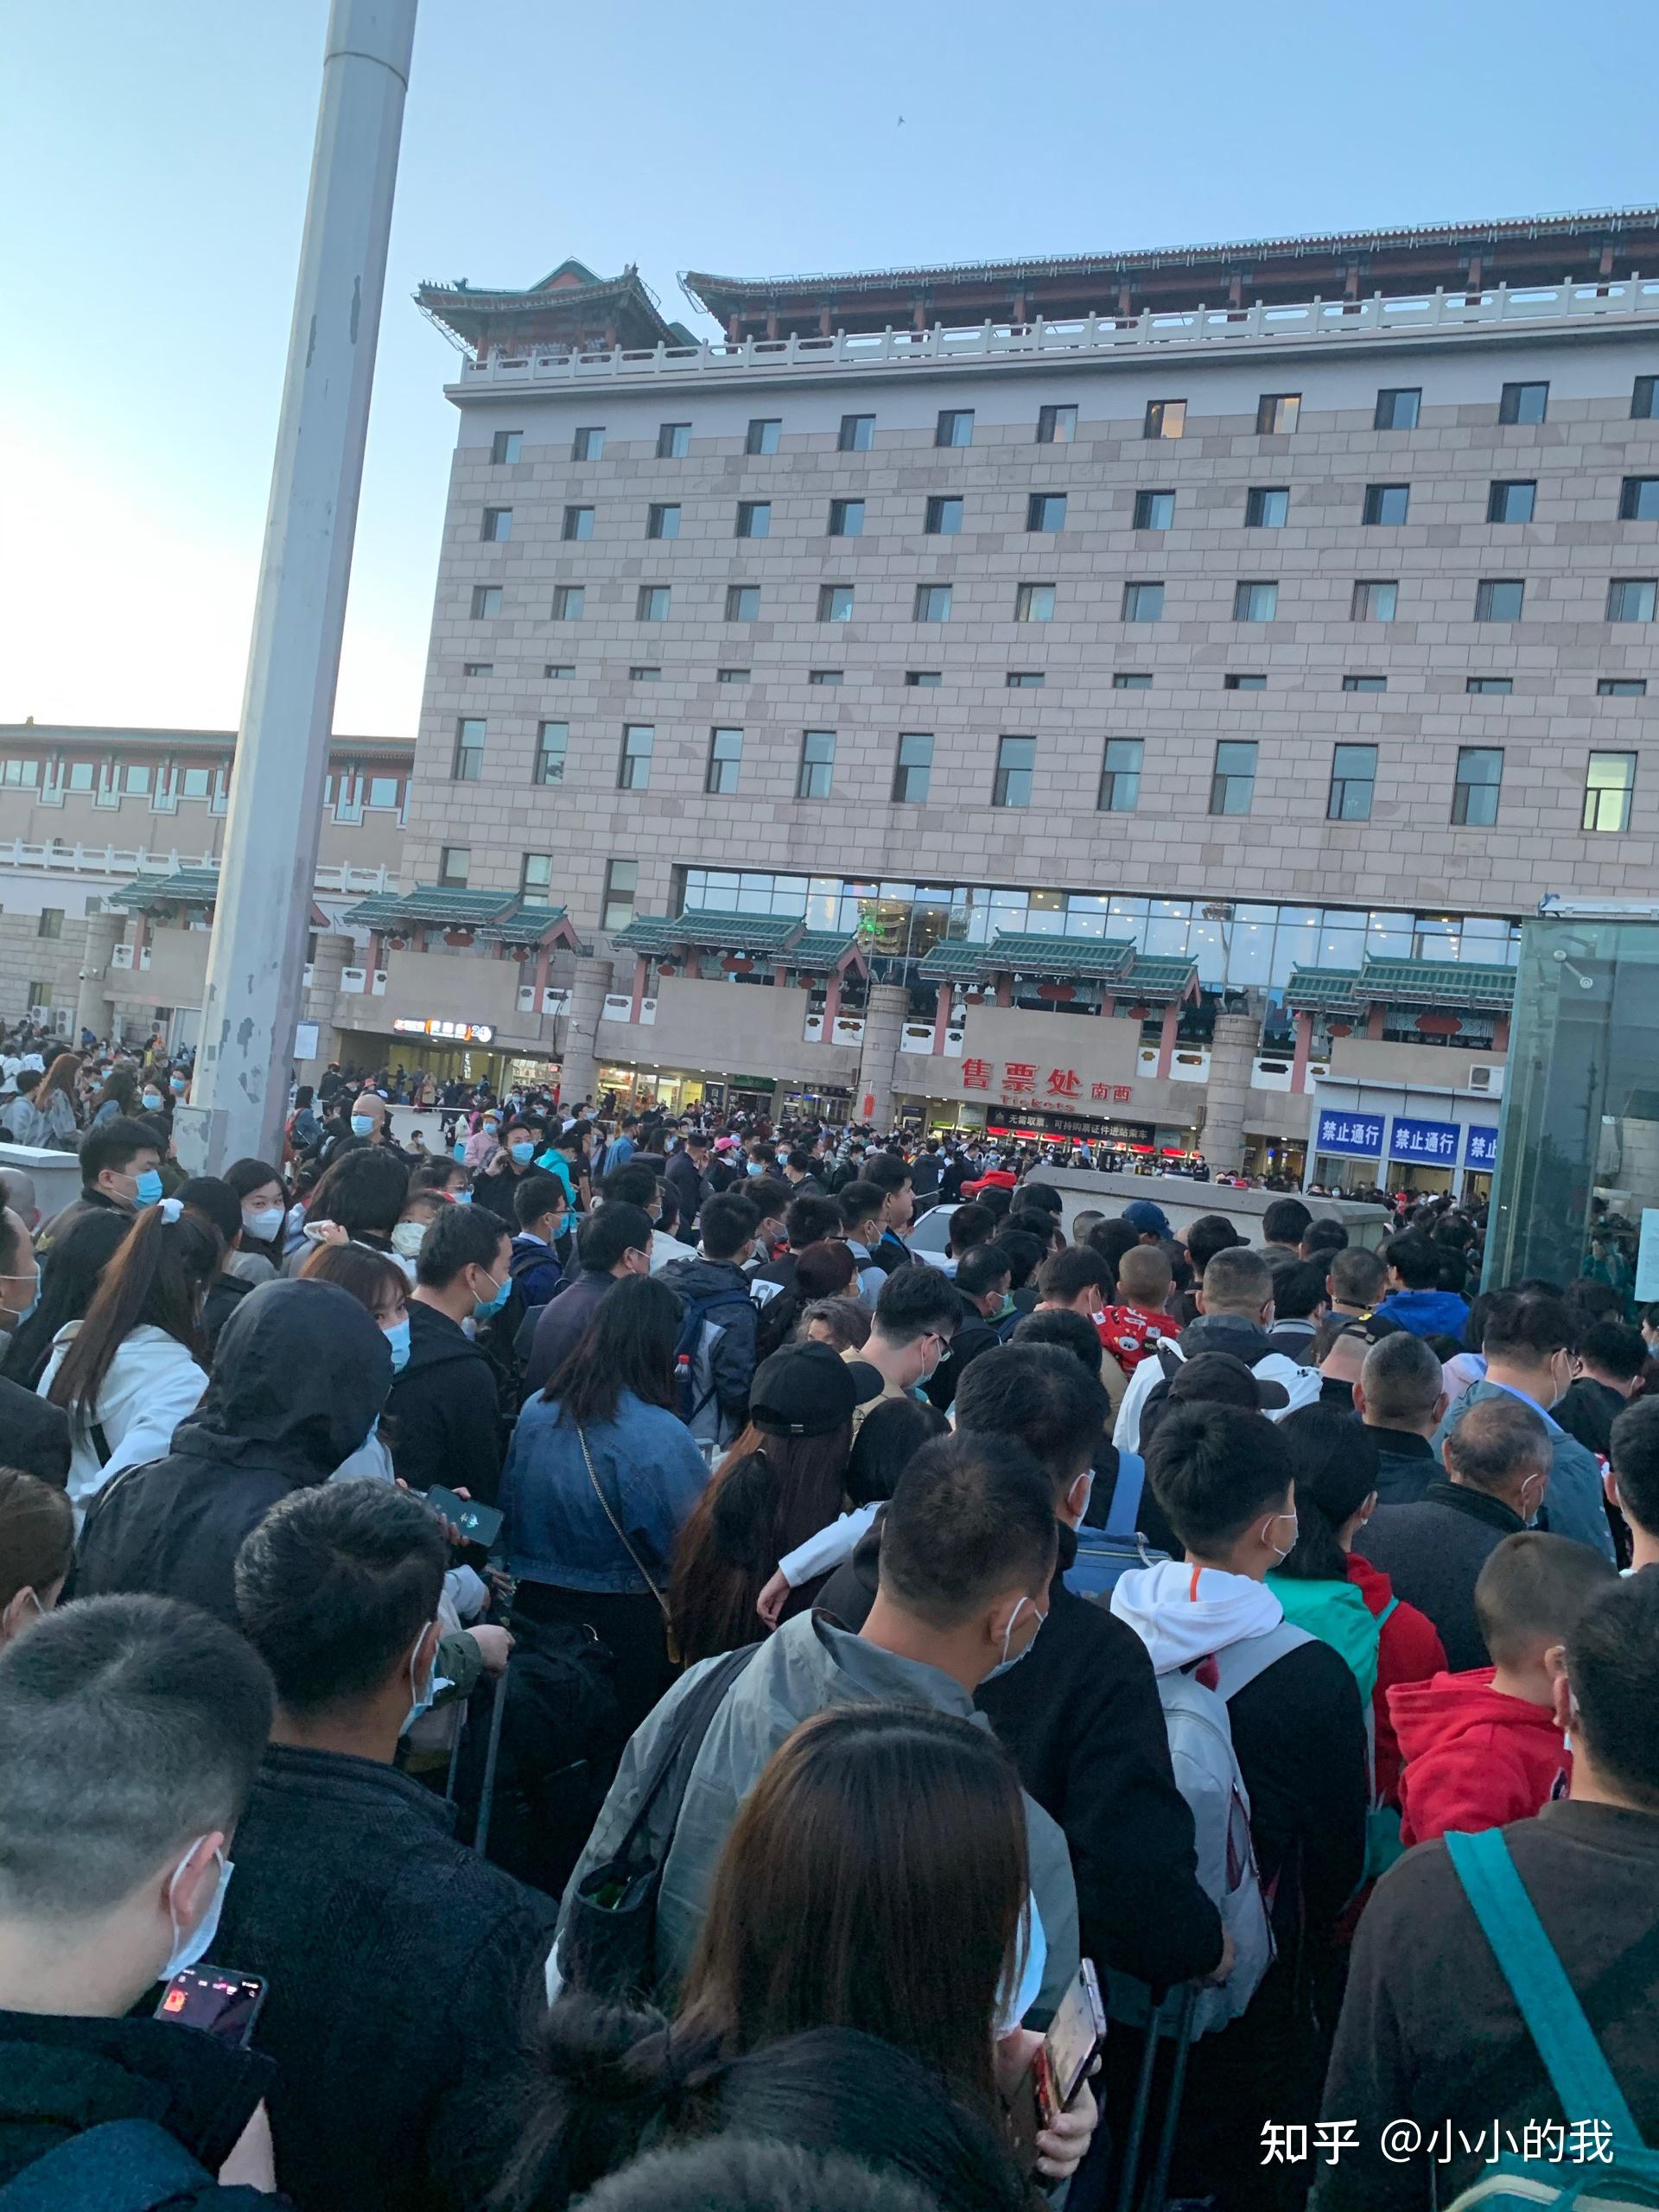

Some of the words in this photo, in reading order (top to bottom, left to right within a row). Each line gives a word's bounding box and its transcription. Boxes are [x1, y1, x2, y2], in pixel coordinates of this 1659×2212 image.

[962, 1058, 1082, 1098] 售票处
[1091, 1082, 1132, 1103] 南西
[1322, 1121, 1379, 1147] 禁止通行
[1395, 1128, 1453, 1154] 禁止通行
[1471, 1136, 1497, 1159] 禁止
